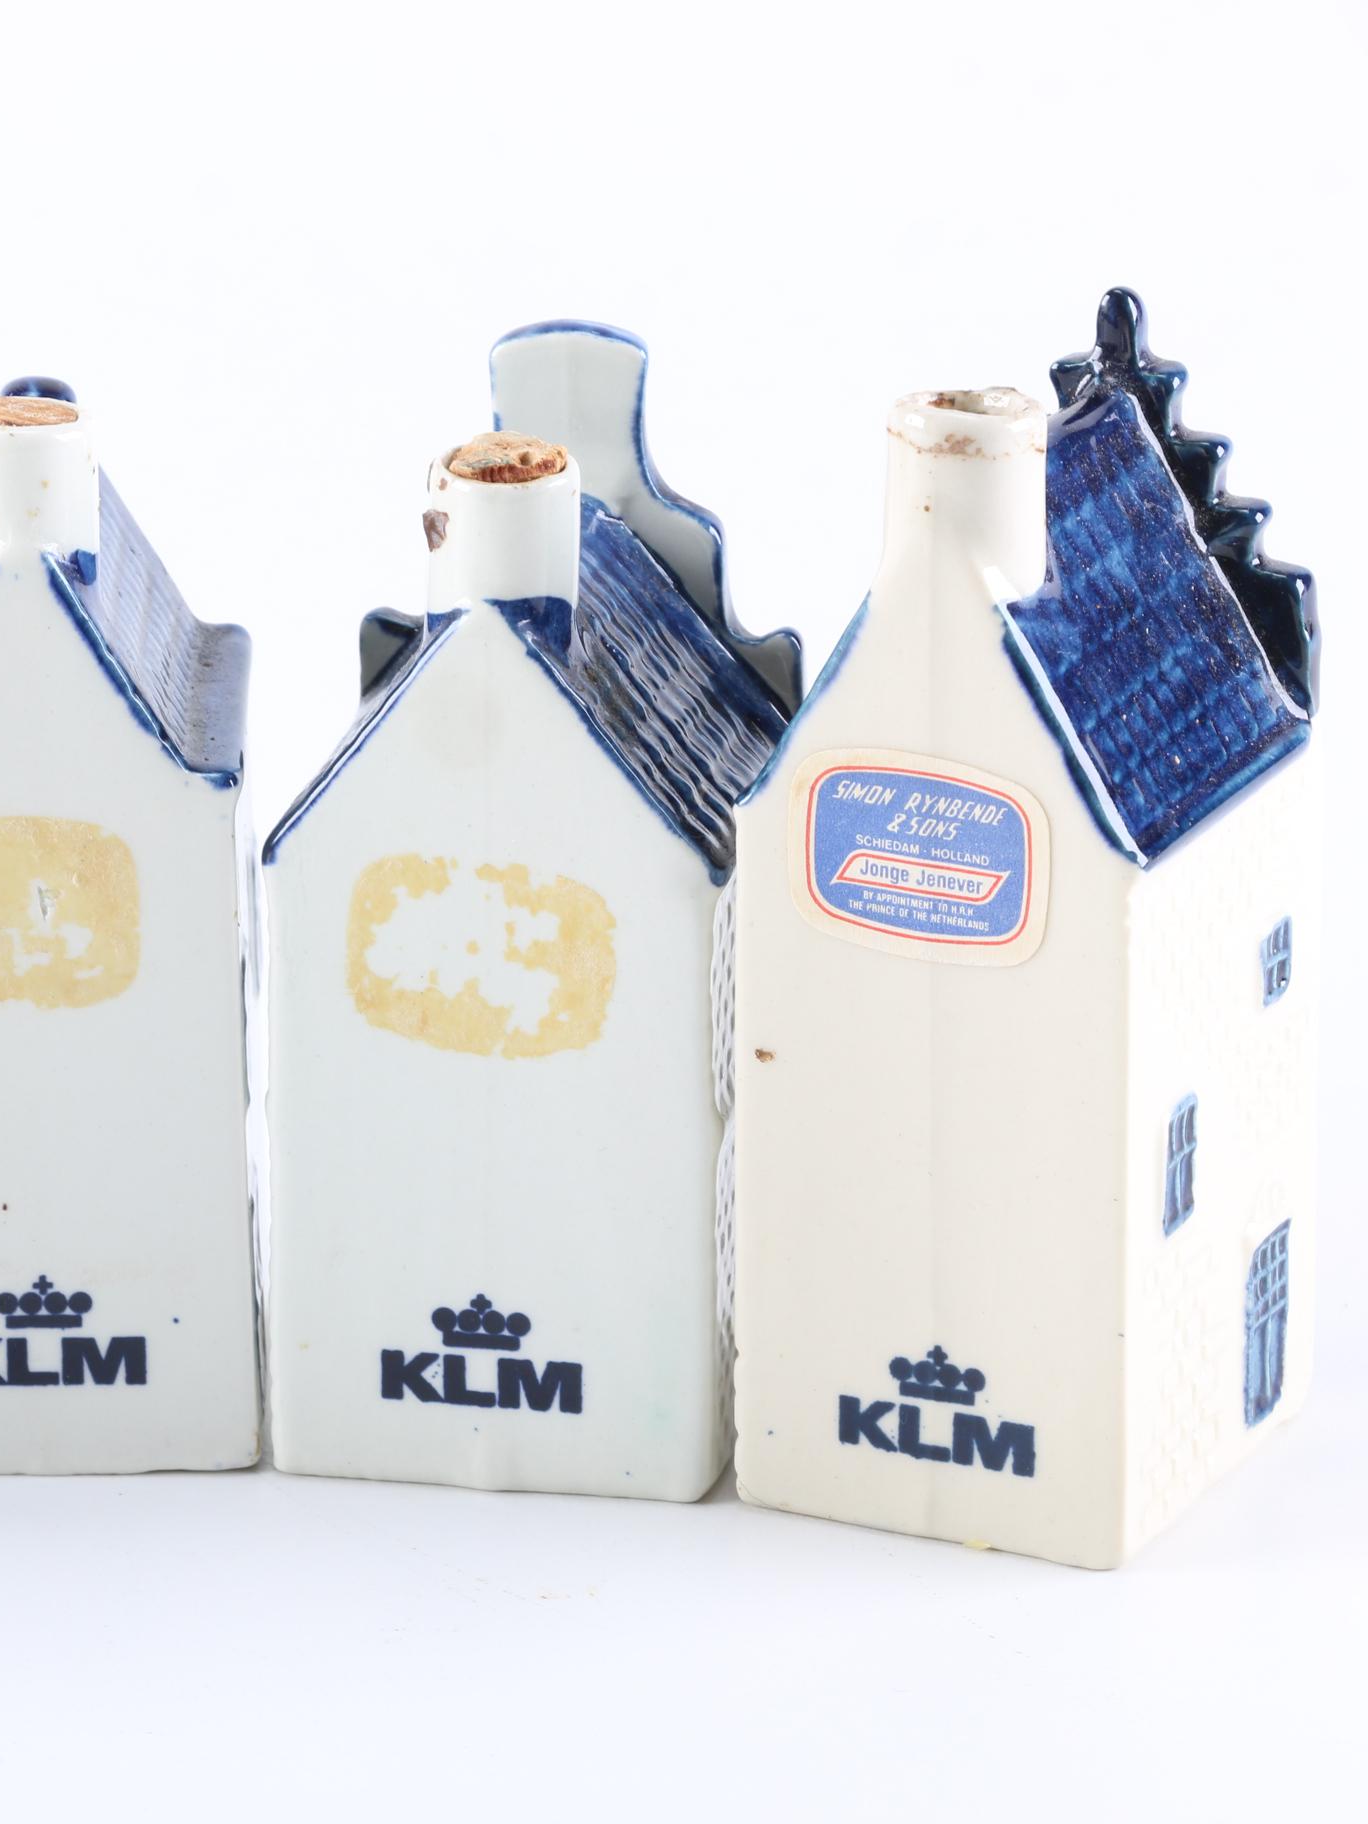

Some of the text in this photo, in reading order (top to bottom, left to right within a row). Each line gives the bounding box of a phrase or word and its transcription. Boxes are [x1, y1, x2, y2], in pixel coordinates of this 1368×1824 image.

[832, 780, 1008, 826] SIMON RYNBENDE
[887, 813, 961, 841] & SONS
[855, 834, 920, 855] SCHIEDAM
[931, 847, 989, 866] HOLLAND
[860, 859, 983, 895] Jonge Jenever
[848, 900, 990, 932] THE PRINCE OF THE NETHERLANDS
[863, 890, 874, 900] BY
[876, 893, 933, 909] APPOINTMENT
[938, 903, 948, 913] TO
[380, 1348, 583, 1414] KLM
[838, 1395, 1035, 1478] KLM
